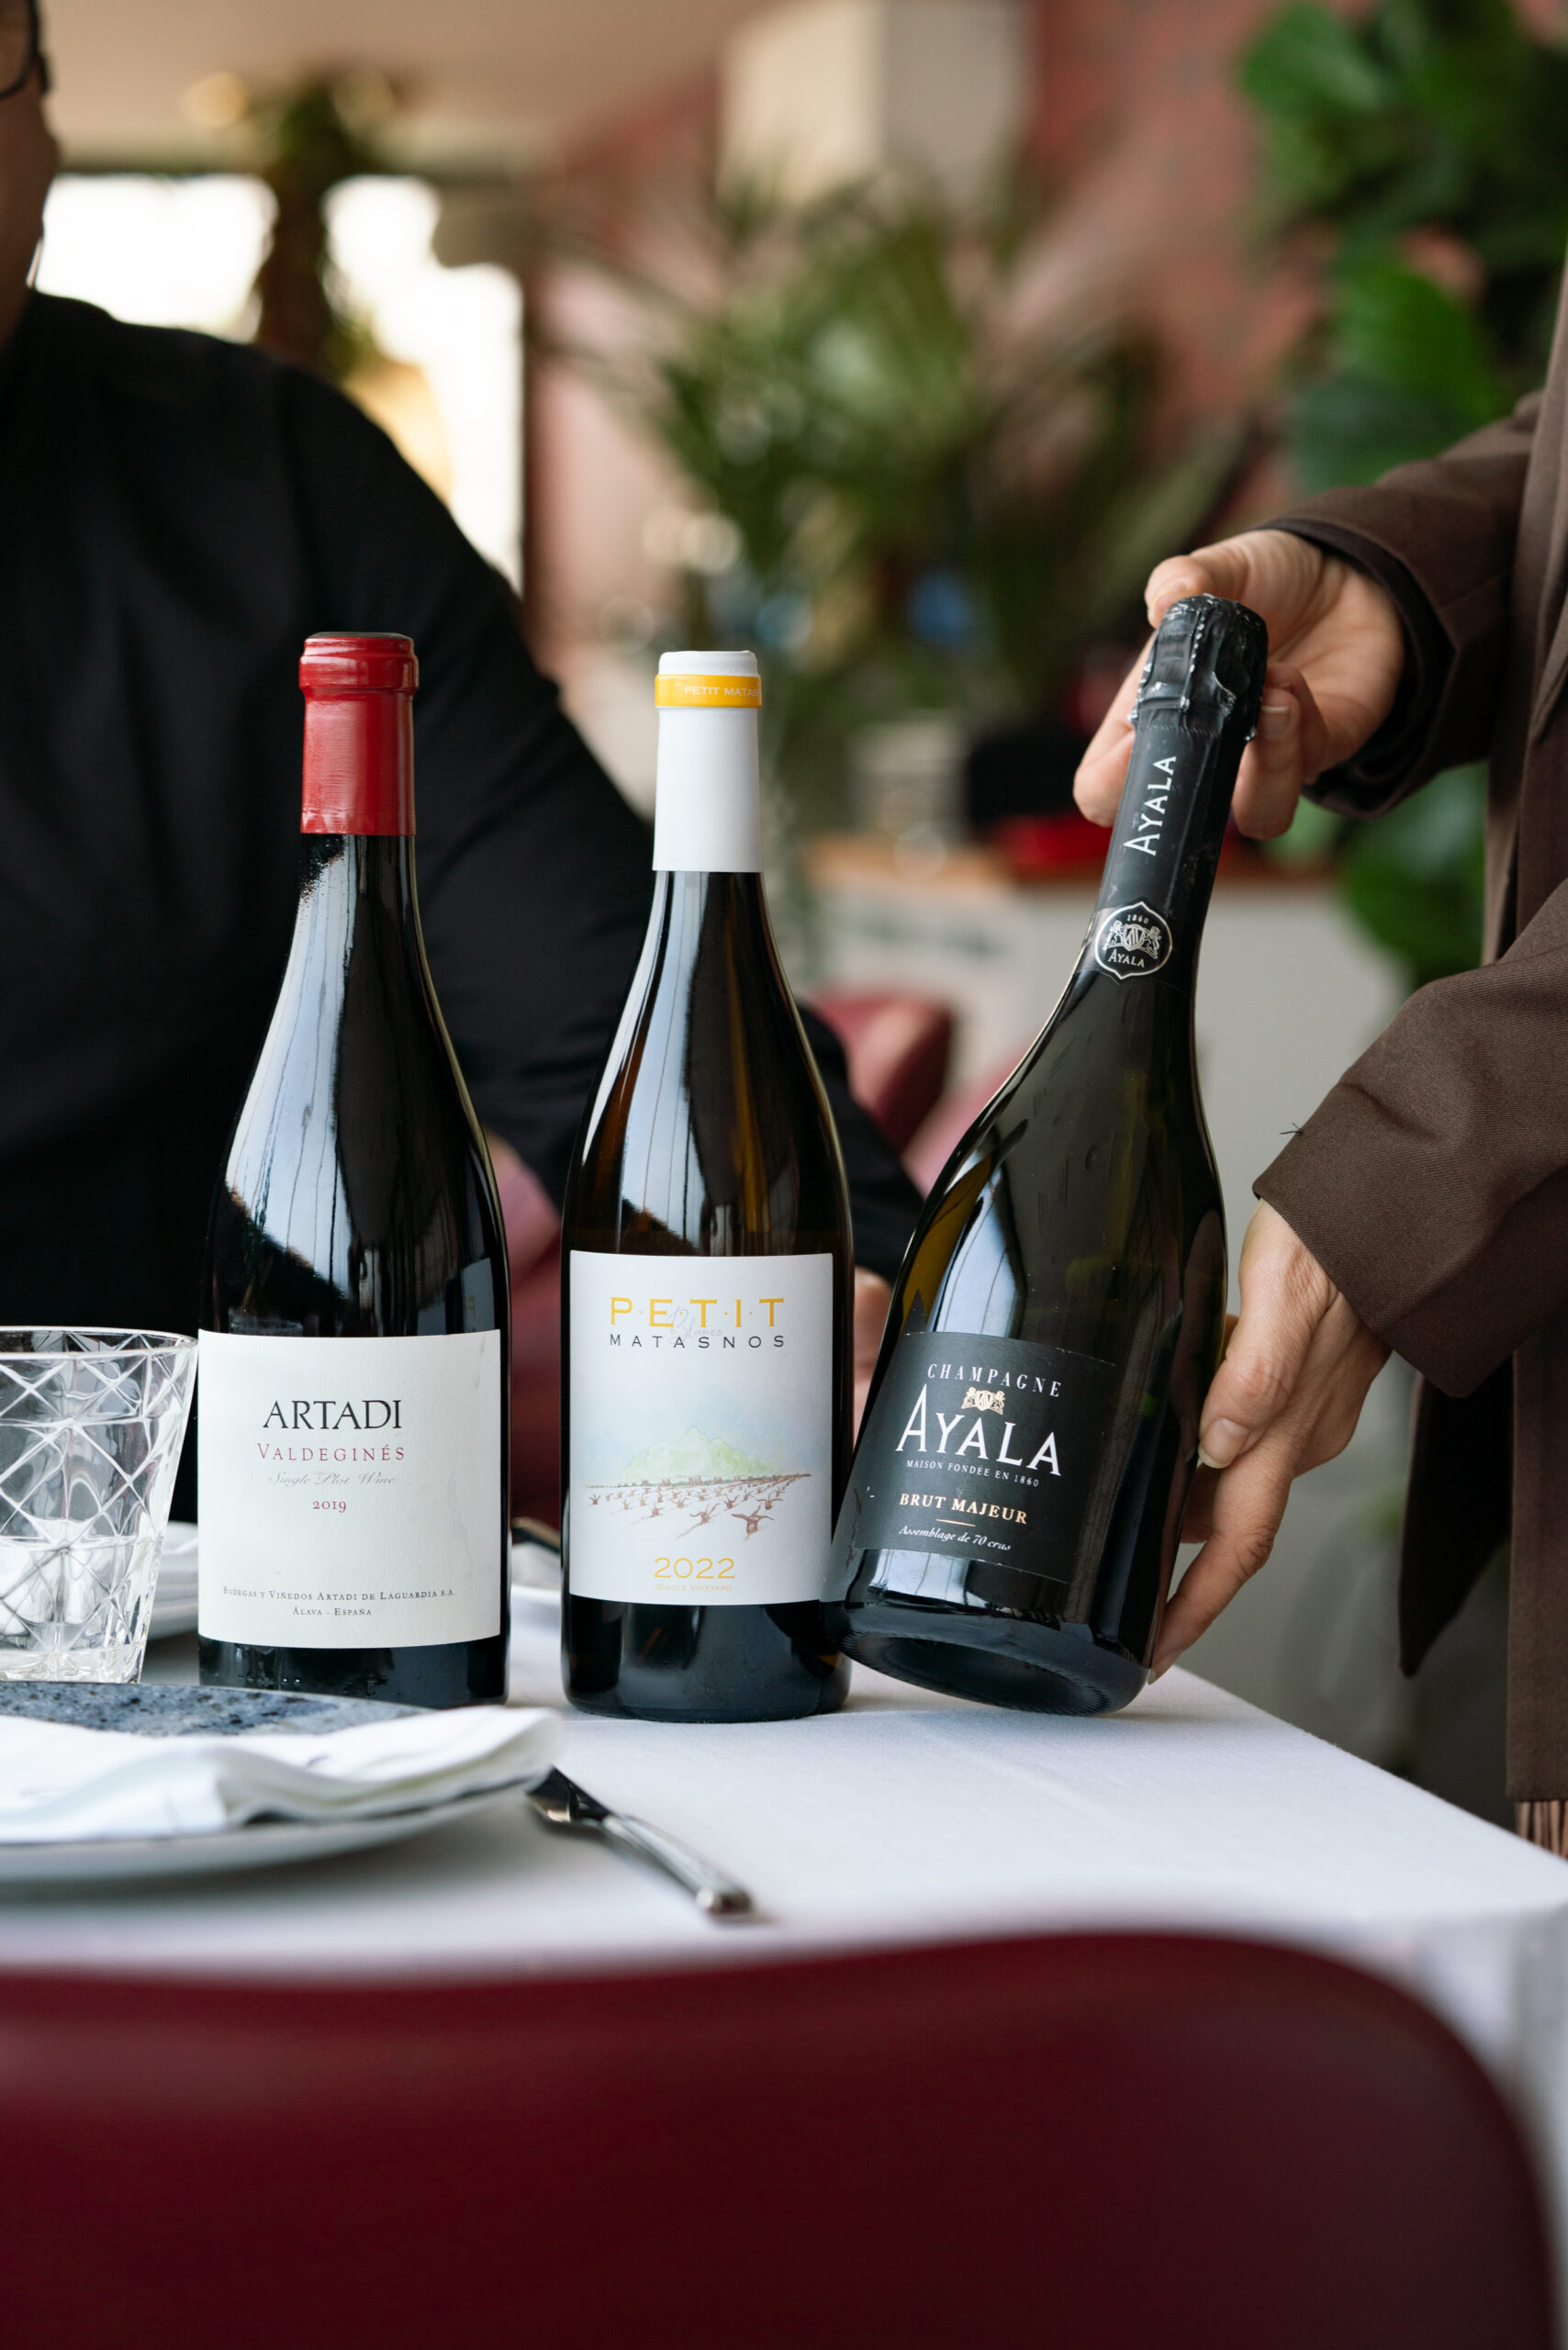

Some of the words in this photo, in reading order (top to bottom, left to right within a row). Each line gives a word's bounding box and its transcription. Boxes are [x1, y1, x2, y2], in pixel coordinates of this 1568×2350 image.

[684, 687, 721, 695] PETIT
[1123, 755, 1177, 856] AYALA
[1126, 913, 1149, 924] 1860
[1107, 948, 1145, 968] AYALA
[610, 1334, 785, 1348] MATASNOS
[927, 1363, 1062, 1398] CHAMPAGNE
[263, 1400, 402, 1429] ARTADI
[895, 1383, 1062, 1477] AYALA
[257, 1443, 405, 1461] VALDEGINÉS
[268, 1471, 311, 1487] Single
[314, 1472, 352, 1485] Plot
[357, 1472, 397, 1485] Wine
[906, 1460, 944, 1470] MAISON
[995, 1471, 1010, 1480] EN
[1014, 1474, 1039, 1487] 1860
[312, 1500, 347, 1513] 2019
[899, 1493, 946, 1509] BRUT
[951, 1498, 1027, 1525] MAJEUR
[899, 1525, 955, 1541] Assemblage
[958, 1531, 971, 1543] de
[972, 1534, 989, 1546] 70
[987, 1540, 1012, 1551] crus
[654, 1557, 735, 1579] 2022
[317, 1592, 357, 1601] ARTADI
[380, 1591, 438, 1600] LAGUARDIA
